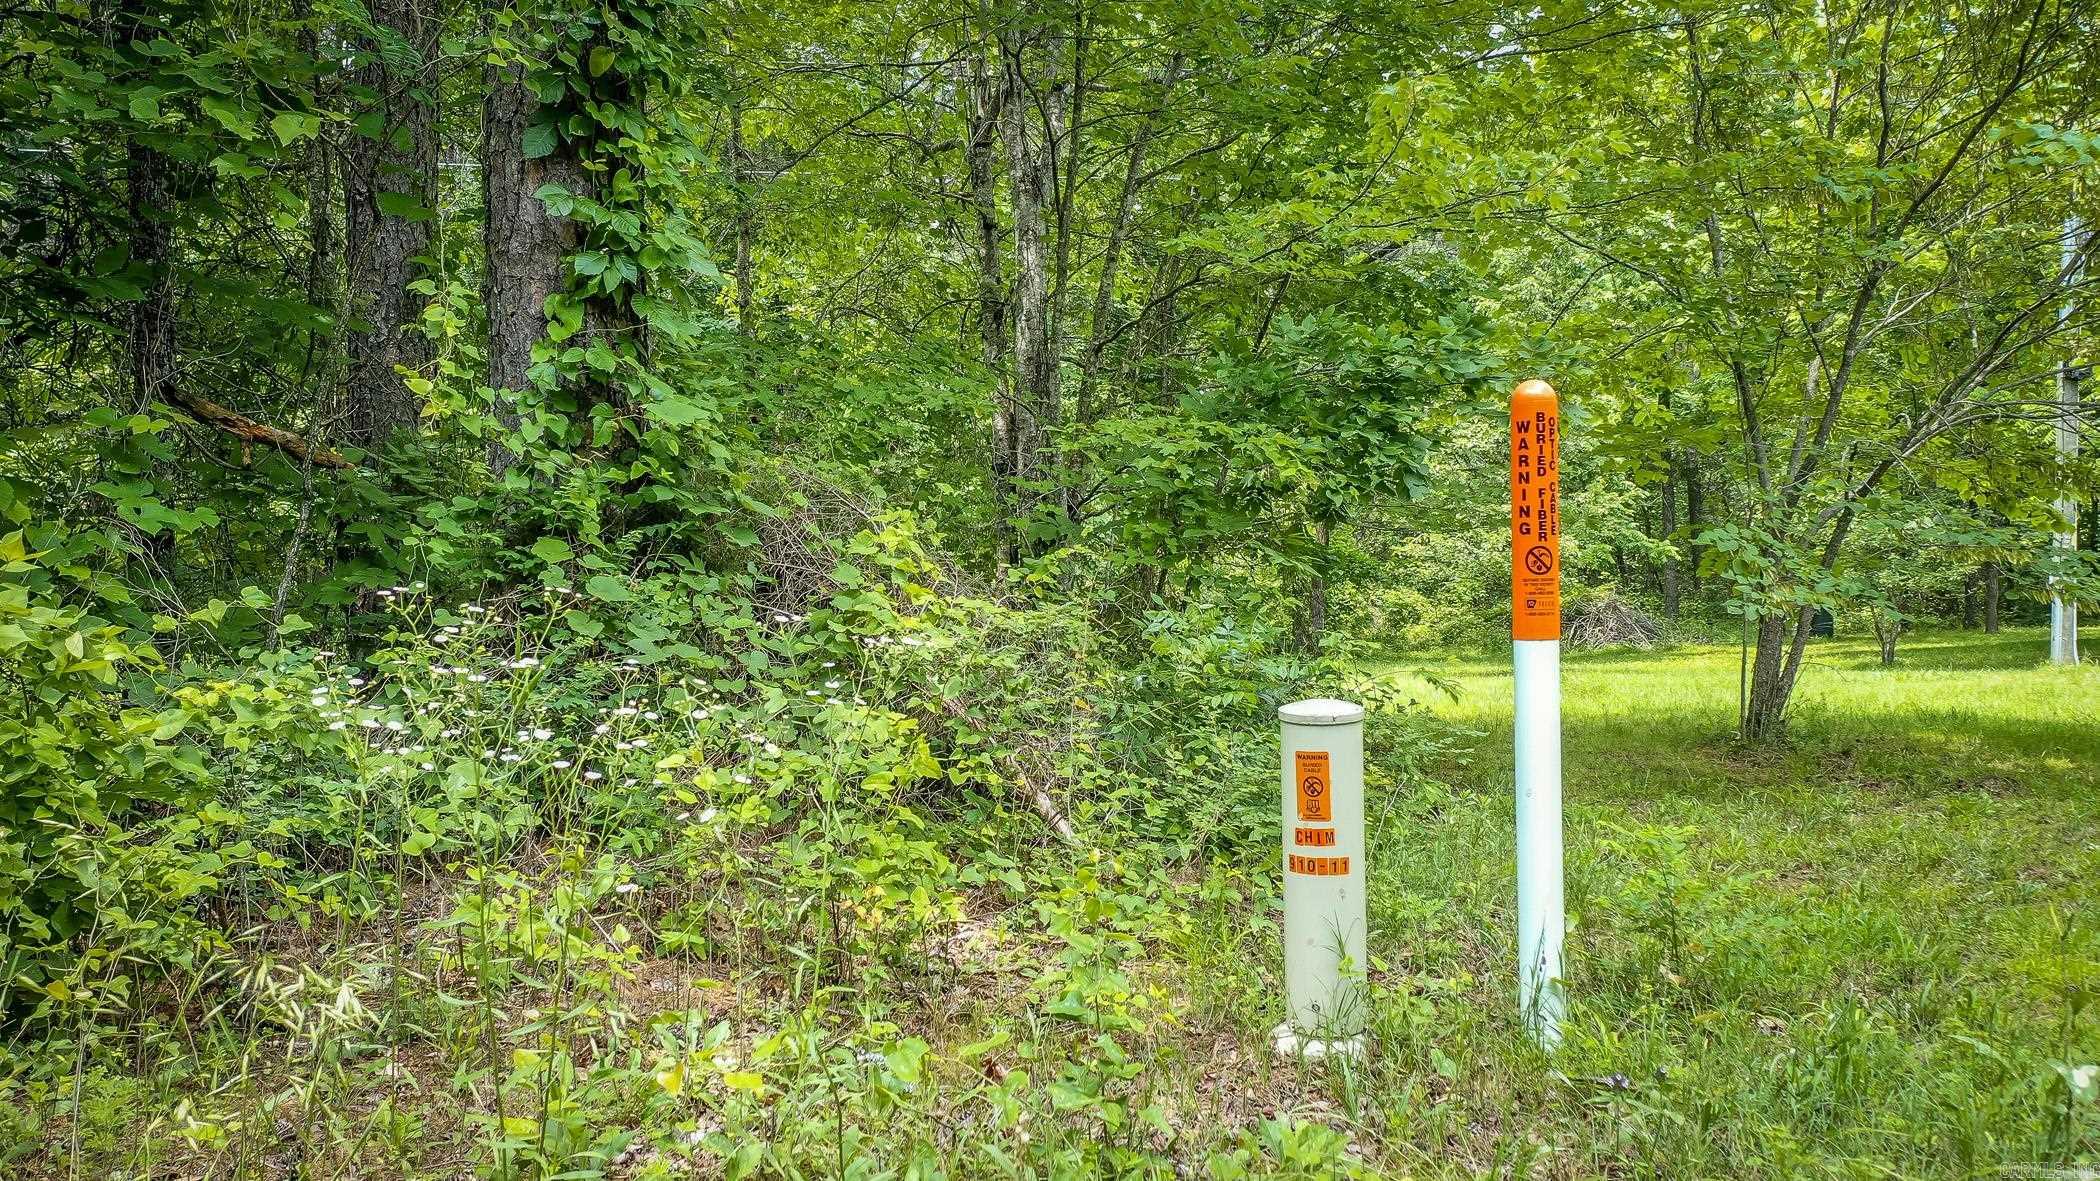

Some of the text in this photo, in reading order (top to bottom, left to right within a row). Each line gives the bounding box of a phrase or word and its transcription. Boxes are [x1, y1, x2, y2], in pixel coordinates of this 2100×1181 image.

[1516, 420, 1531, 535] WARNING
[1536, 412, 1547, 542] BURIED FIBER
[1296, 830, 1334, 845] CHIM
